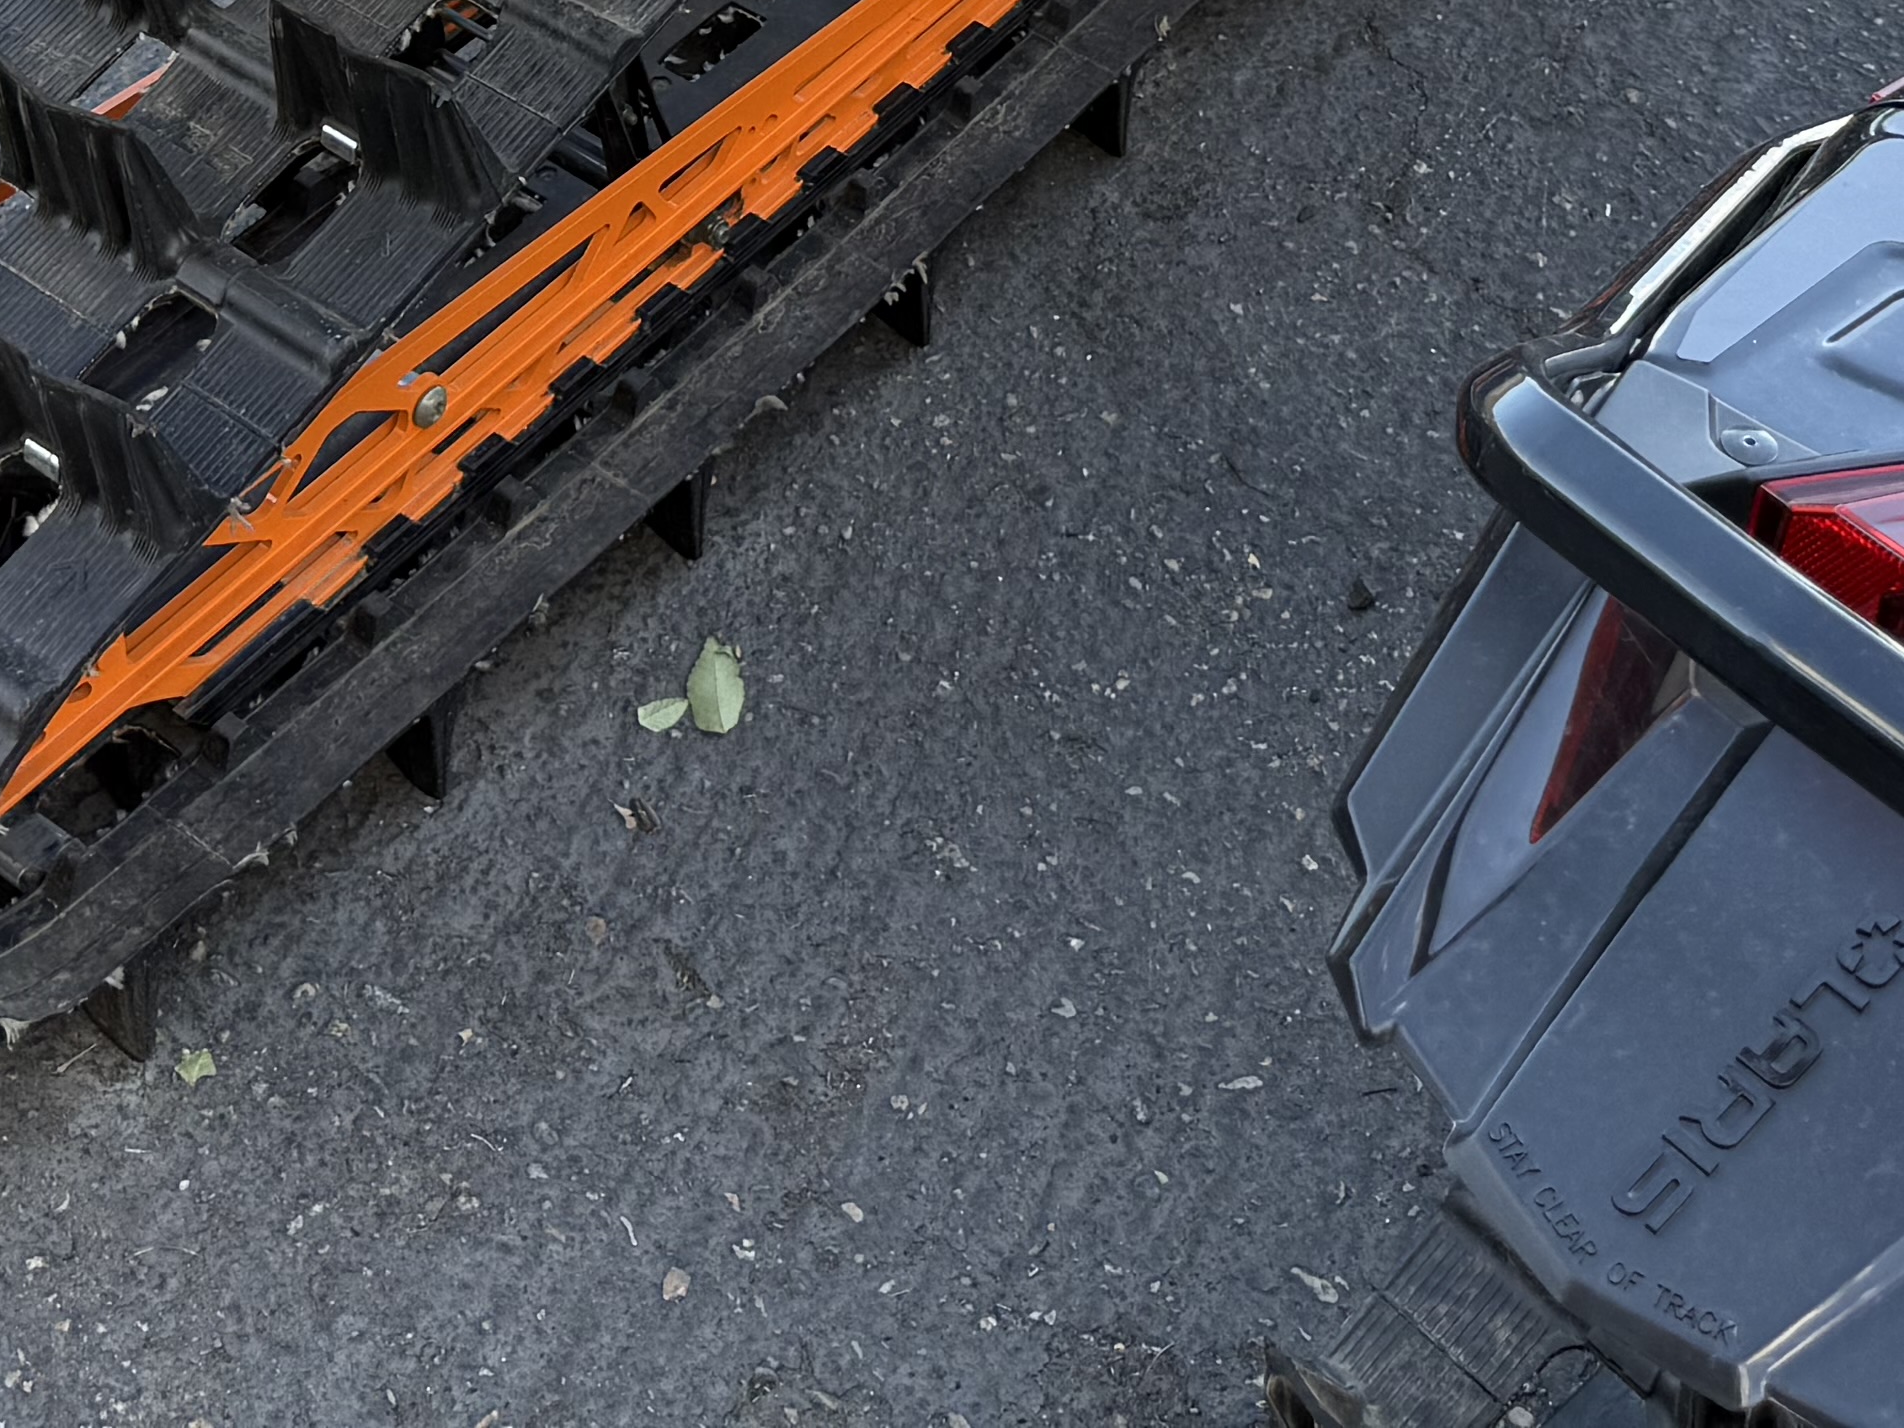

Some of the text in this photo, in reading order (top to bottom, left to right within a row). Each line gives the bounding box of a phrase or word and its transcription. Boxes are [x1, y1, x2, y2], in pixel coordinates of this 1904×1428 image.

[1487, 1121, 1739, 1346] STAY CLEAR OF TRACK
